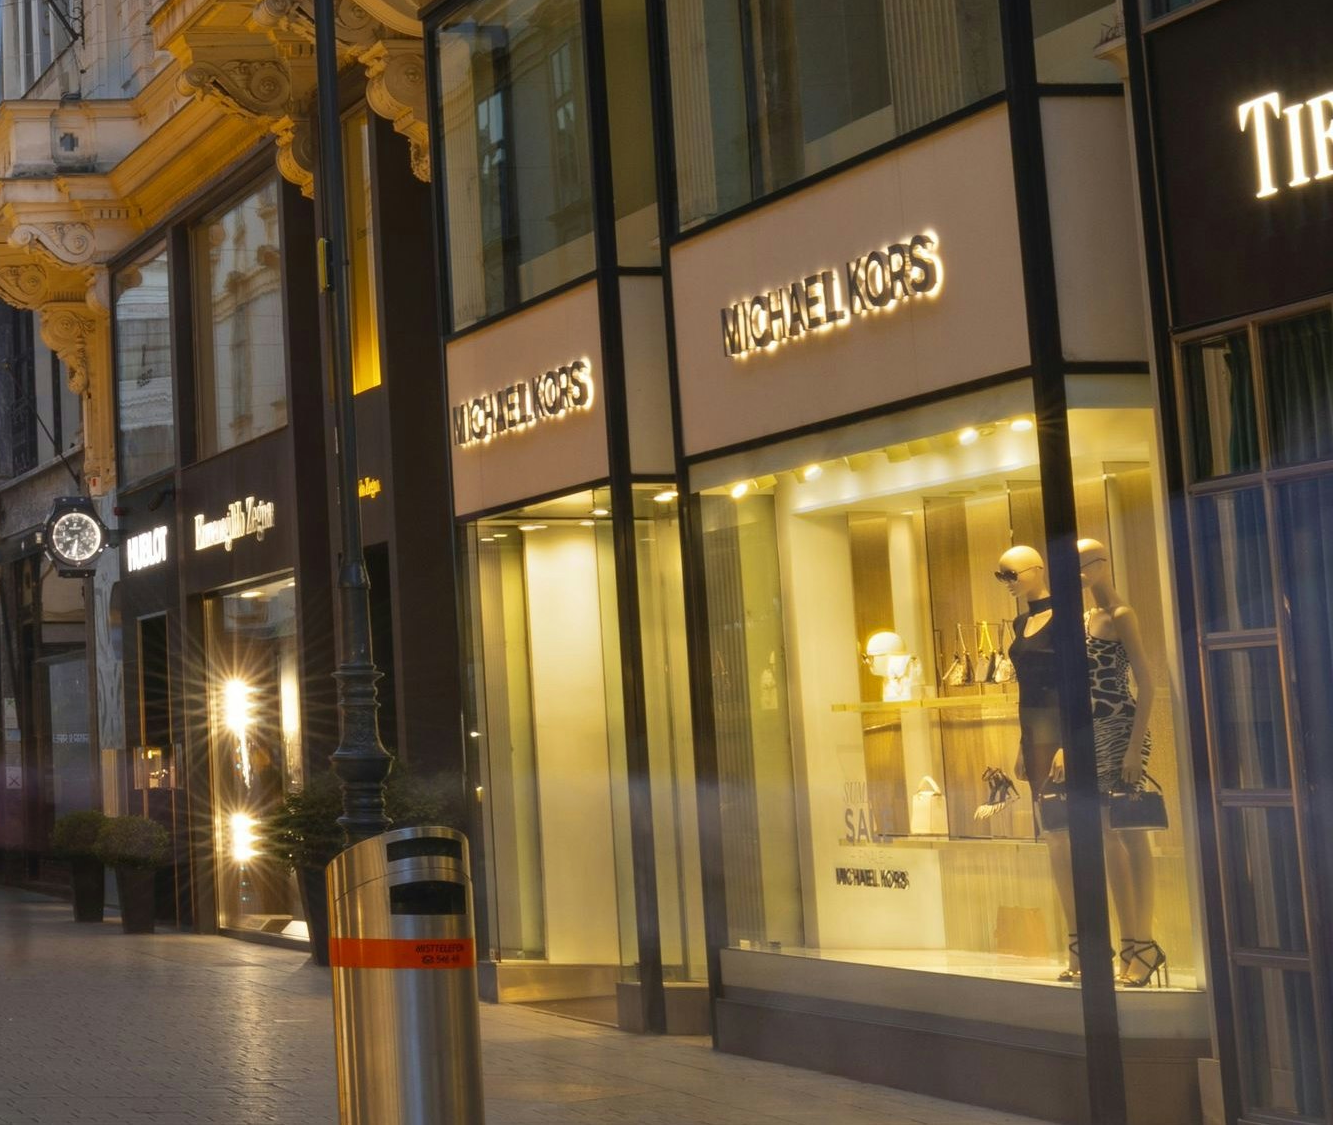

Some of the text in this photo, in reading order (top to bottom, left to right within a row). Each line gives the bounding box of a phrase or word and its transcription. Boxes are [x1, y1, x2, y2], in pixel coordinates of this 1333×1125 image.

[720, 233, 940, 357] MICHAEL KORS
[452, 360, 591, 447] MICHAEL KORS
[245, 496, 275, 542] Zegna
[127, 526, 169, 572] HUBLOT
[835, 868, 911, 890] MICHAEL KORS
